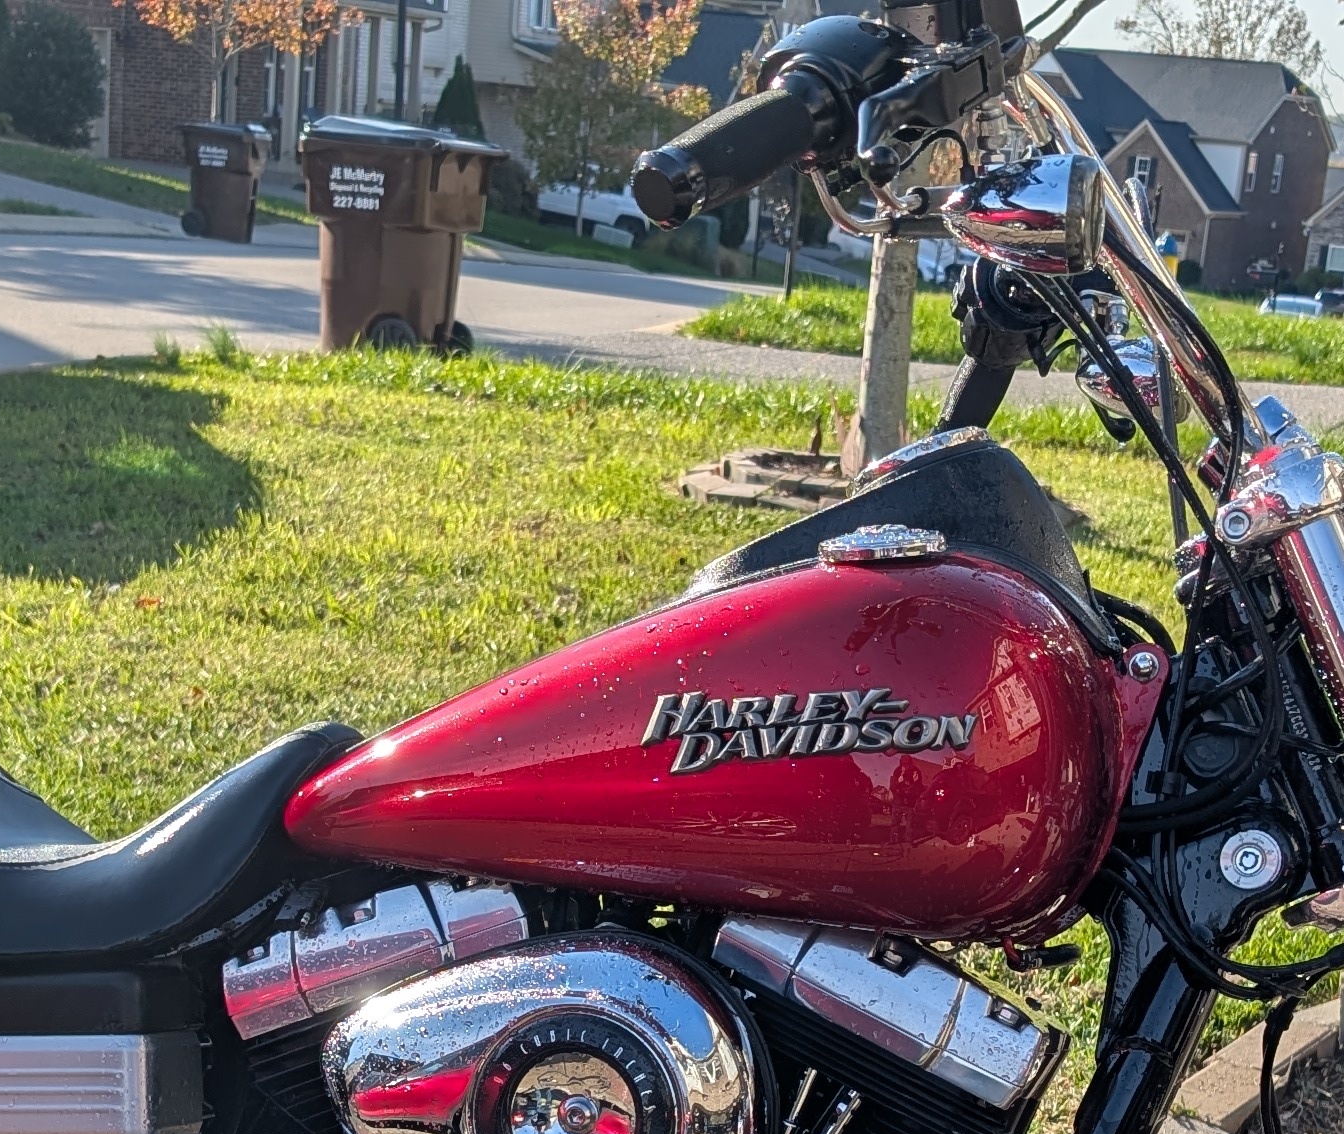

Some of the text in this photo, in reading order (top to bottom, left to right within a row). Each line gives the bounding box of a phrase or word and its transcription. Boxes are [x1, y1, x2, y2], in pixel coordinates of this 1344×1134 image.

[669, 713, 979, 775] DAVIDSON
[519, 1028, 587, 1055] CUBIC
[601, 1037, 657, 1114] INCHES
